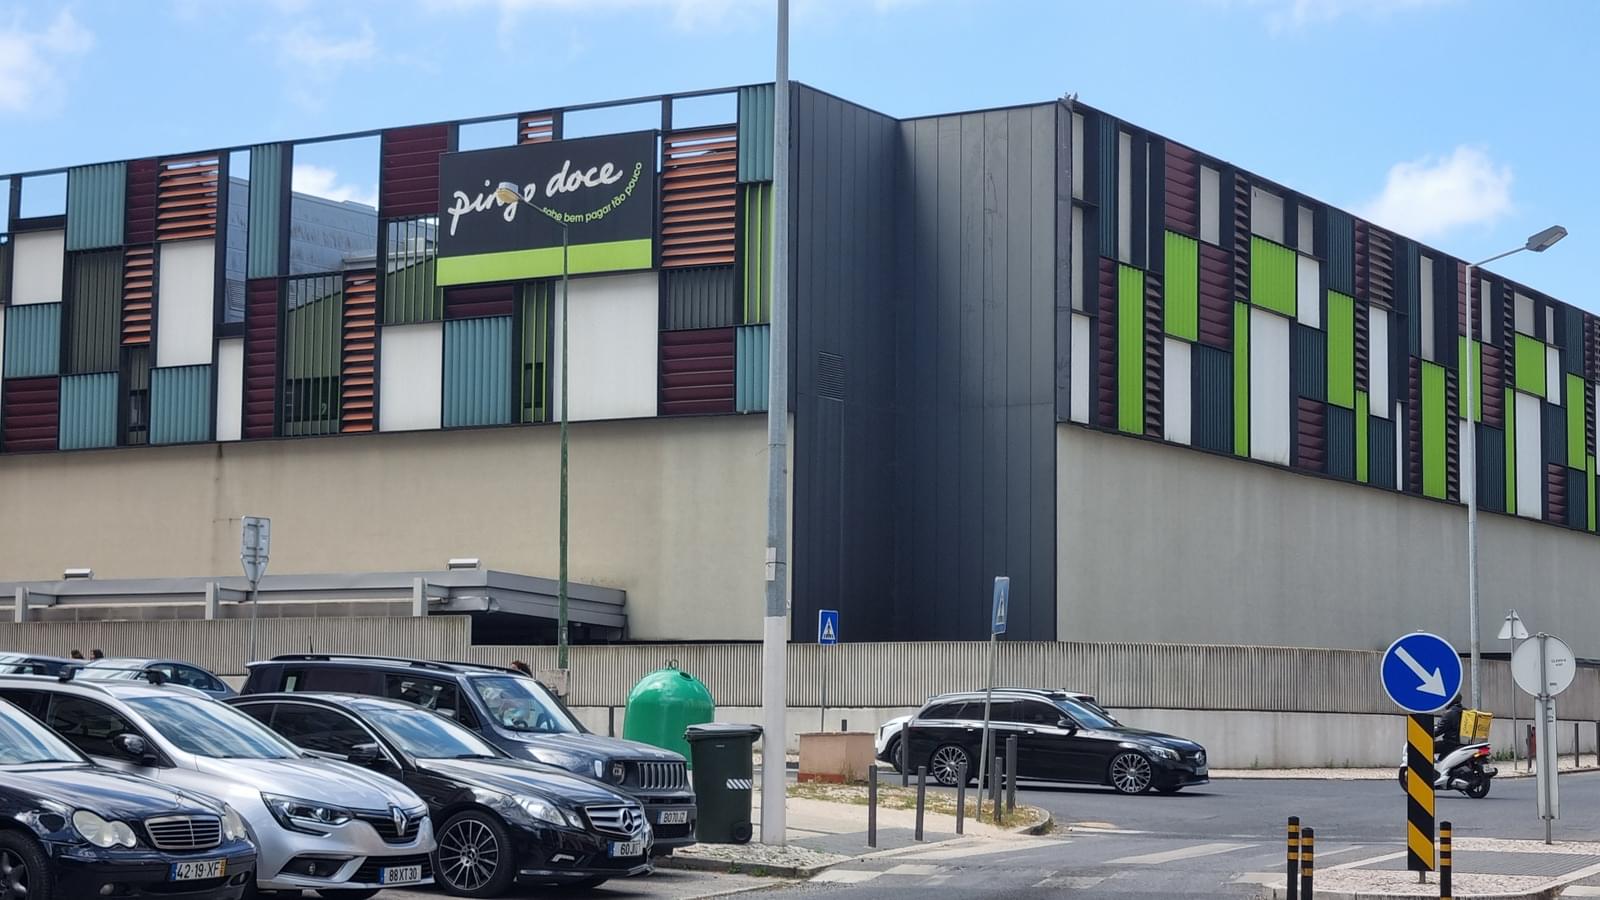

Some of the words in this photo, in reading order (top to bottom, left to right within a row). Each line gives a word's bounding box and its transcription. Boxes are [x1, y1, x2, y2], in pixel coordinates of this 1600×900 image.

[543, 206, 563, 221] sabe
[564, 213, 584, 222] bem
[586, 203, 612, 223] pagar
[612, 193, 626, 208] tão
[625, 162, 642, 196] pouco
[546, 160, 623, 197] doce
